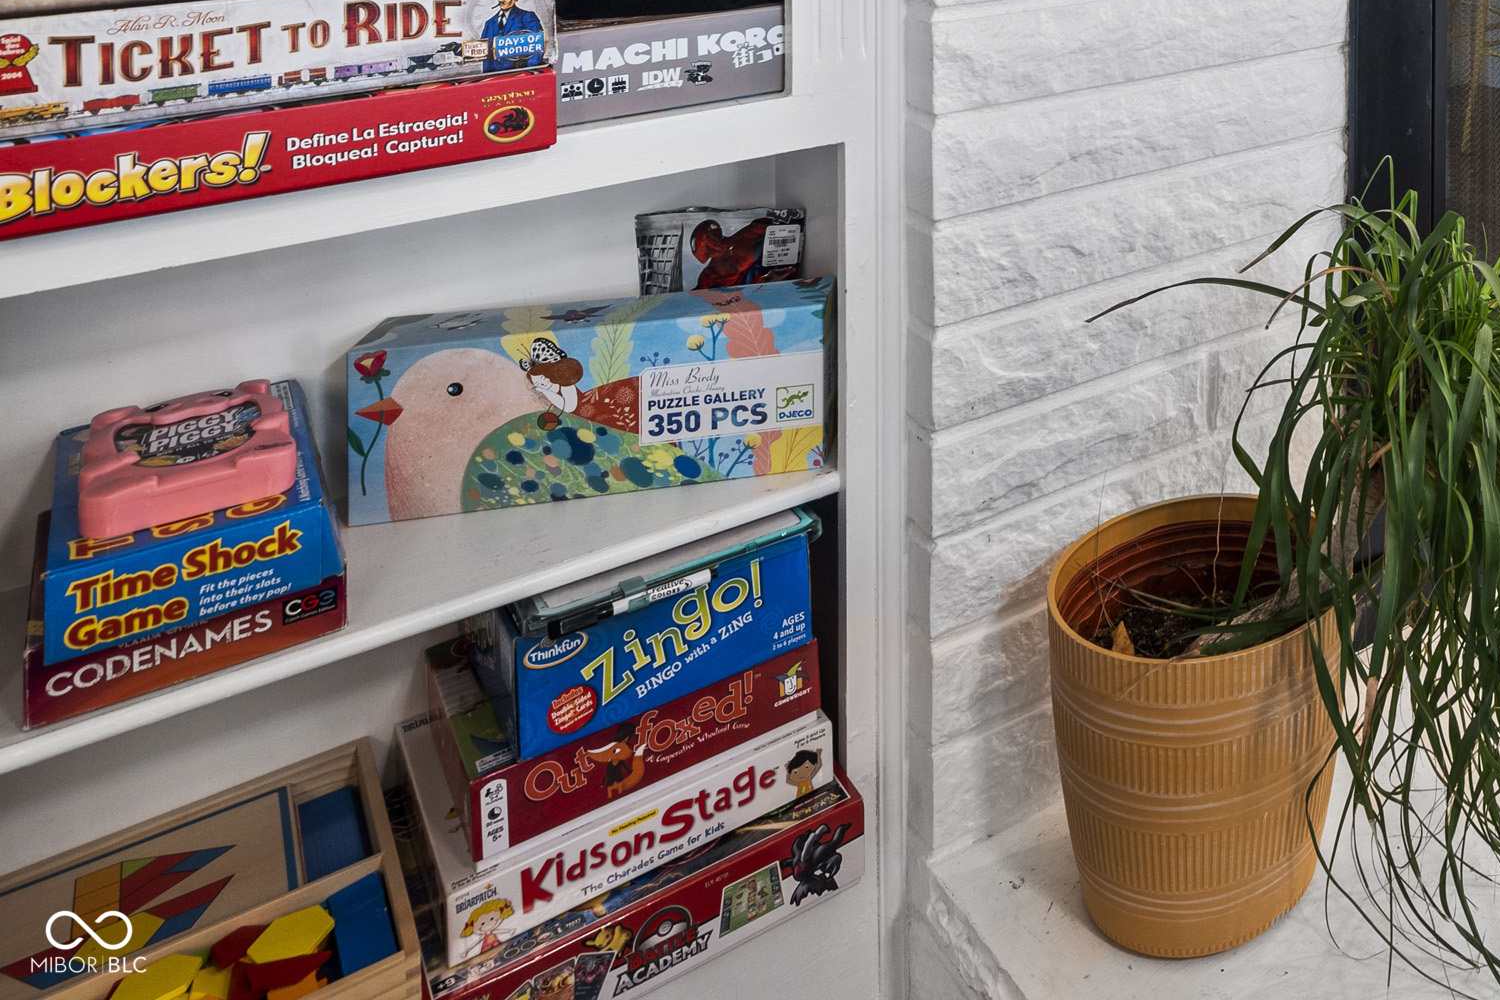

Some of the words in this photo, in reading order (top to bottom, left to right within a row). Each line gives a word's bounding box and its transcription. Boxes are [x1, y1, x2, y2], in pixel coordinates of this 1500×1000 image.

[107, 15, 151, 35] Alan
[153, 14, 179, 30] R.
[182, 11, 226, 27] Moon
[48, 21, 271, 88] TICKET
[281, 22, 331, 54] TO
[343, 0, 463, 48] RIDE
[498, 37, 524, 46] DAYS
[561, 37, 688, 74] MACHI
[697, 25, 784, 56] KORO
[1, 71, 23, 80] 2004
[642, 67, 682, 85] IDW
[286, 132, 349, 151] Define
[352, 127, 375, 142] La
[379, 112, 468, 137] Estraegia!
[292, 144, 378, 169] Bloquea!
[386, 130, 464, 155] Captura!
[0, 132, 270, 223] Blockers!
[650, 371, 679, 388] Miss
[685, 367, 720, 385] Birdy
[648, 395, 700, 411] PUZZLE
[704, 388, 766, 405] GALLERY
[778, 409, 812, 420] DJECO
[149, 409, 239, 442] PIGGY
[648, 410, 701, 437] 350
[711, 402, 768, 431] PCS
[148, 420, 238, 453] PIGGY
[65, 563, 178, 614] Time
[182, 520, 304, 581] Shock
[199, 584, 216, 595] Fit
[217, 579, 237, 590] the
[238, 567, 274, 586] pieces
[199, 593, 223, 606] into
[225, 585, 253, 599] their
[254, 576, 281, 591] slots
[199, 602, 238, 617] before
[240, 594, 265, 608] they
[266, 582, 292, 599] pop!
[652, 587, 681, 600] COLORS
[64, 597, 189, 650] Game
[580, 557, 764, 707] Zingo!
[774, 632, 778, 640] 4
[780, 627, 794, 638] and
[796, 622, 806, 634] up
[782, 612, 805, 628] AGES
[45, 610, 273, 697] CODENAMES
[635, 661, 683, 699] BINGO
[684, 643, 711, 664] with
[718, 611, 753, 641] ZING
[788, 634, 806, 646] players
[551, 686, 584, 709] Includes
[551, 691, 592, 719] Double-Sided
[575, 700, 593, 713] Cards
[774, 687, 811, 708] GAMEWRIGHT
[523, 746, 596, 801] Out
[634, 670, 754, 752] foxed!
[656, 742, 695, 763] Cooperative
[697, 724, 730, 743] Whodunit
[487, 826, 504, 838] AGES
[618, 820, 637, 832] Reading
[637, 810, 656, 825] Required
[492, 833, 502, 842] 5+
[520, 842, 607, 914] Kids
[658, 766, 776, 844] Stage
[581, 881, 604, 896] The
[607, 857, 654, 883] Charades
[658, 843, 684, 859] Game
[687, 834, 702, 846] for
[705, 820, 725, 837] Kids
[456, 887, 498, 914] BRIARPATCH
[628, 923, 701, 970] BATTLE
[612, 929, 714, 997] ACADEMY
